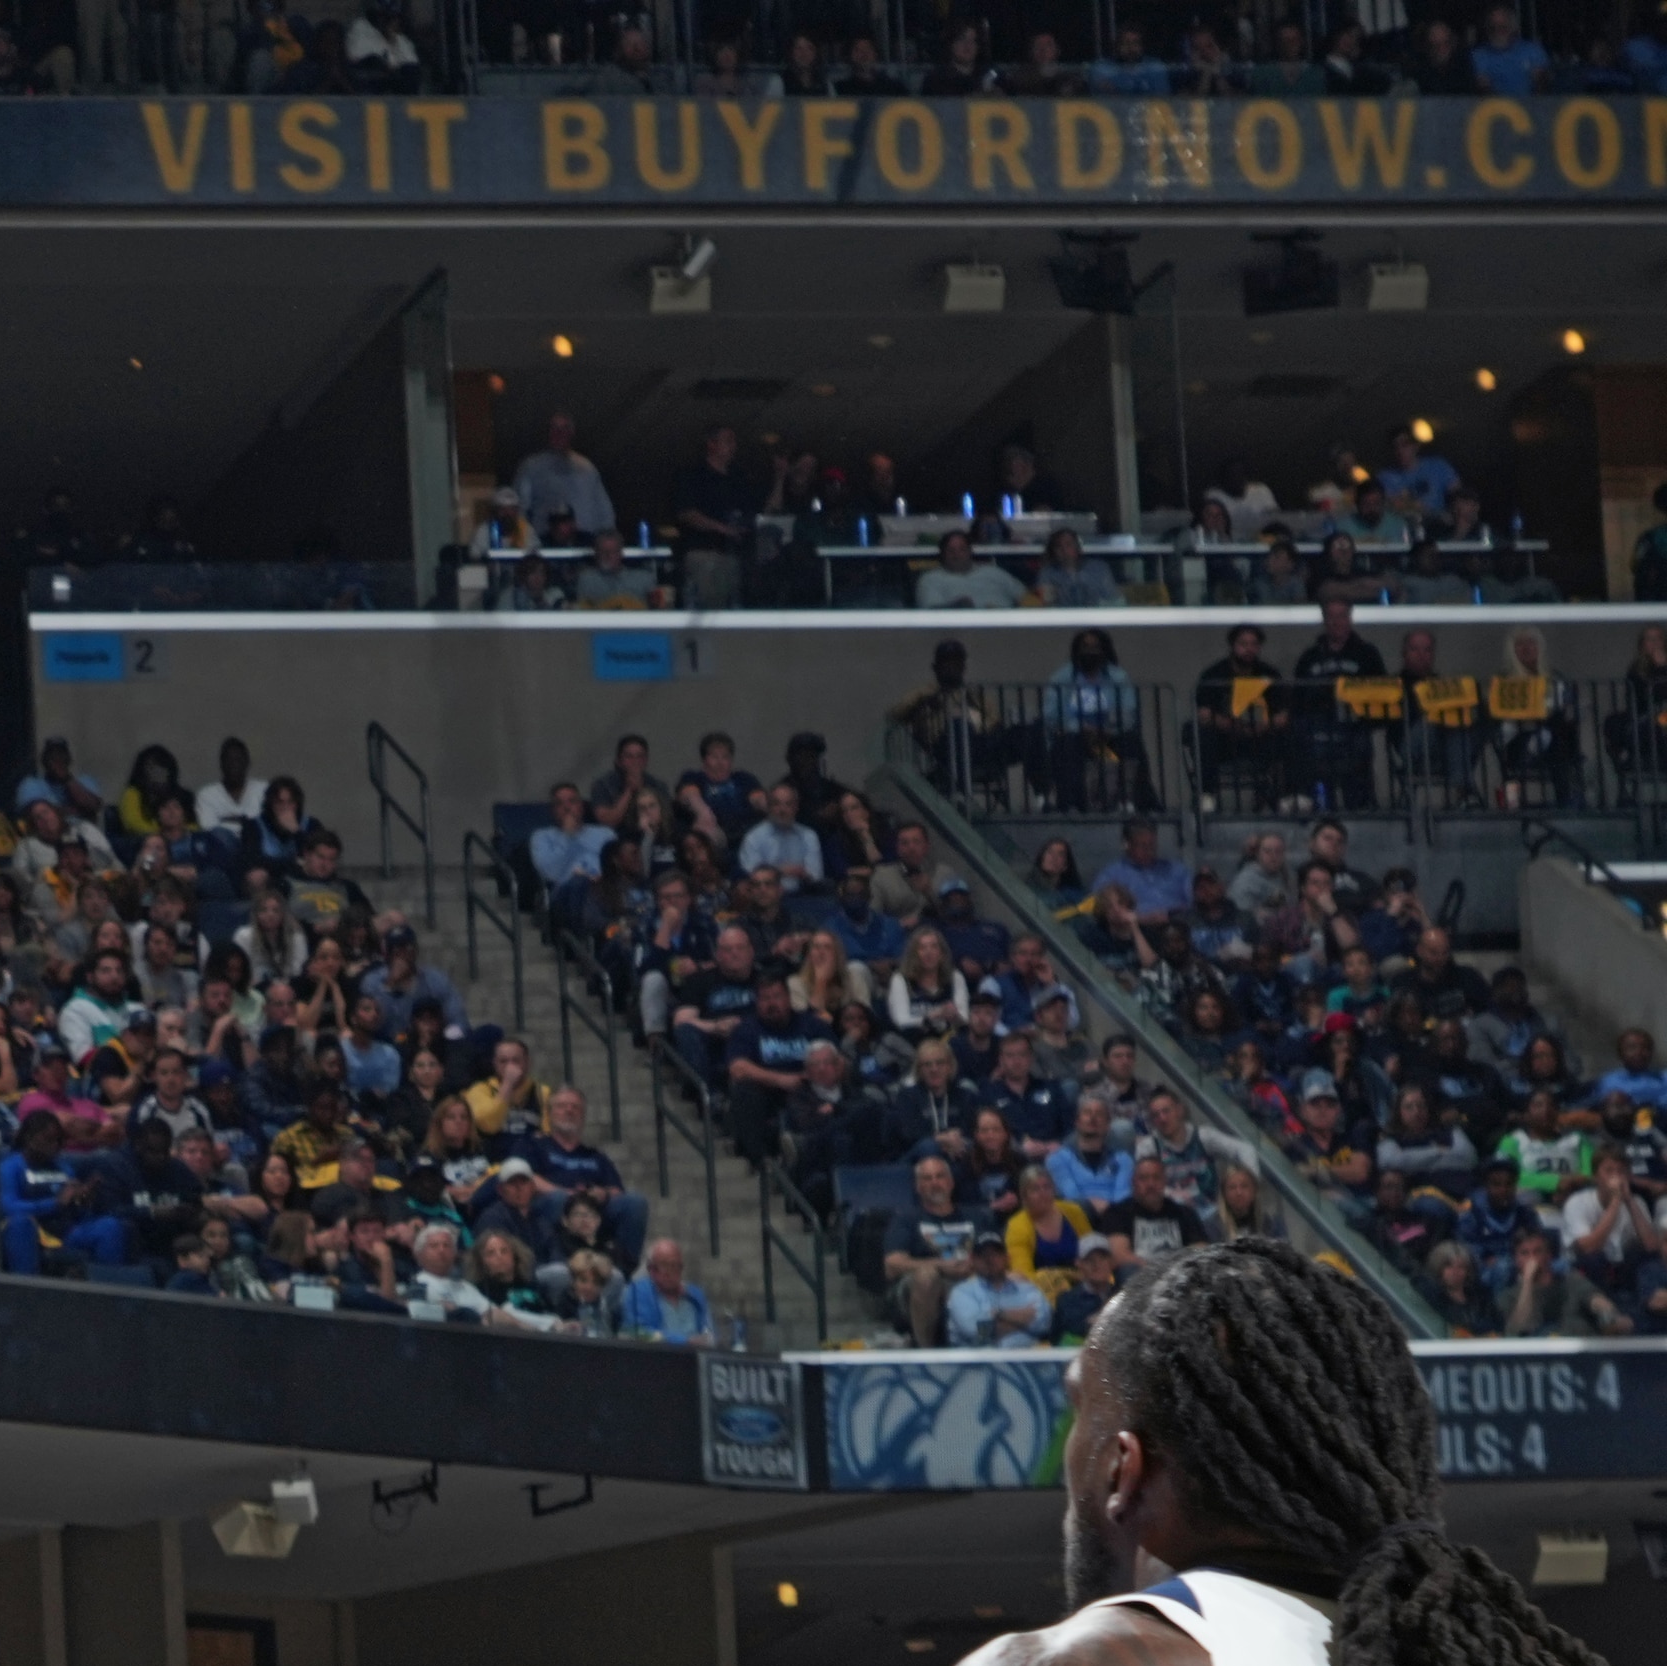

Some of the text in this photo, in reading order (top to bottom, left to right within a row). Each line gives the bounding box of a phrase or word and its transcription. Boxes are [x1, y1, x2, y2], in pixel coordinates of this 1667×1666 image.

[140, 99, 1667, 193] VISIT BUYFORDNOW.CO
[134, 639, 157, 674] 2
[711, 1364, 789, 1404] BUILT
[1428, 1362, 1621, 1415] MEOUTS: 4
[714, 1443, 795, 1476] TOUGH
[1521, 1422, 1547, 1472] 4
